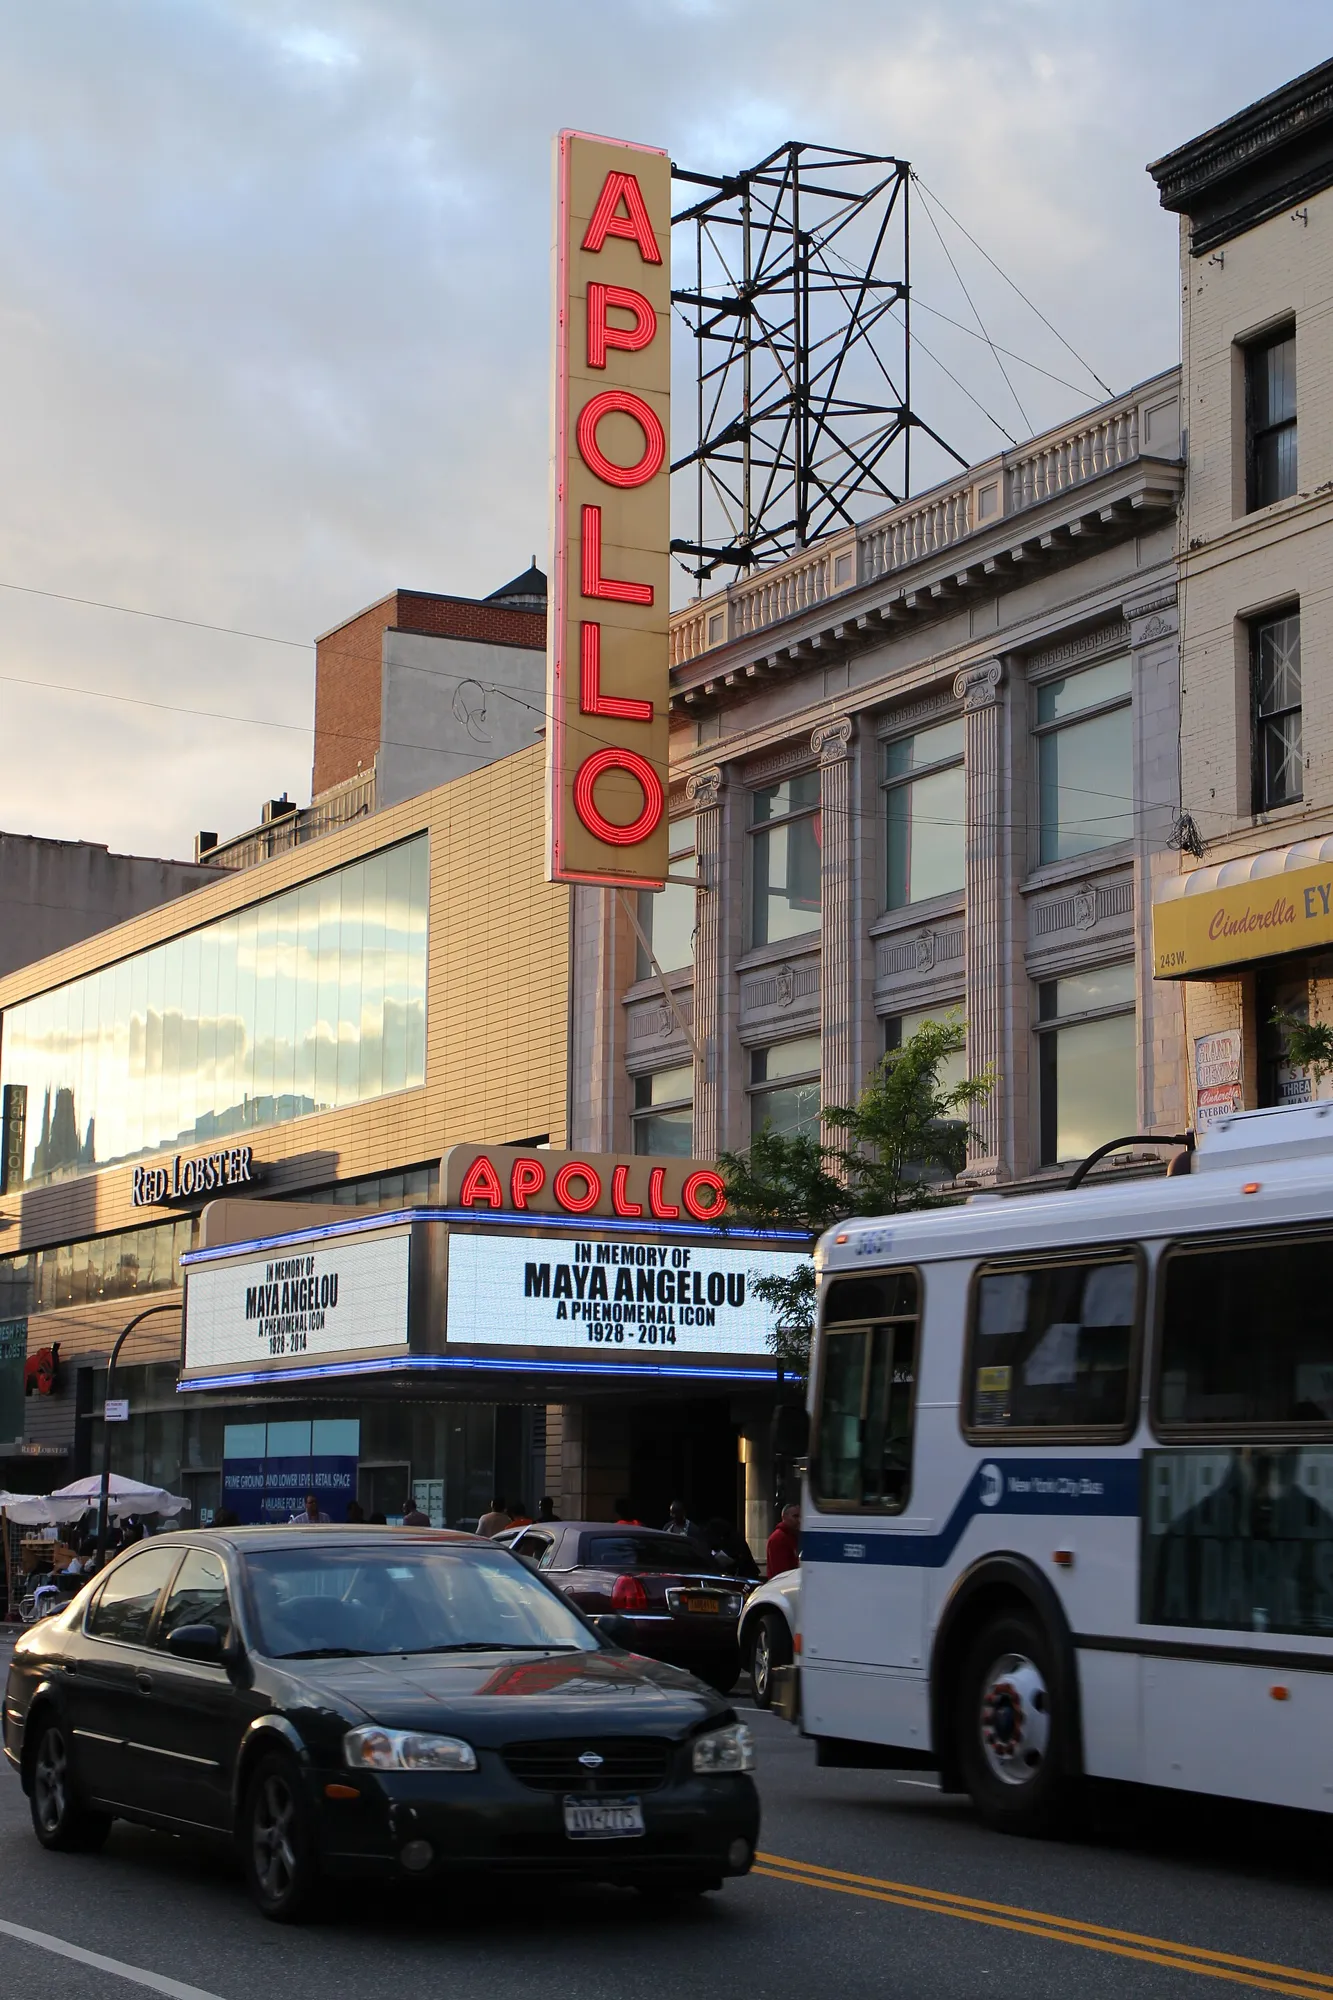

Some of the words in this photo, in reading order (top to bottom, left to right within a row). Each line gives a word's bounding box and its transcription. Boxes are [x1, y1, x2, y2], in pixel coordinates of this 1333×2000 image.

[573, 170, 667, 847] APOLLO
[1208, 897, 1297, 941] Cinderella
[1303, 882, 1332, 919] EY
[1197, 1038, 1232, 1064] GRAND
[1282, 1080, 1311, 1097] THREA
[131, 1166, 167, 1207] RED
[170, 1147, 252, 1199] LOBSTER
[460, 1155, 728, 1221] APOLLO
[575, 1243, 592, 1264] IN
[596, 1244, 668, 1268] MEMORY
[671, 1248, 691, 1268] OF
[266, 1263, 274, 1283] IN
[274, 1258, 305, 1281] MEMORY
[305, 1256, 315, 1277] OF
[246, 1283, 279, 1320] MAYA
[281, 1273, 339, 1315] ANGELOU
[524, 1262, 608, 1301] MAYA
[614, 1267, 745, 1307] ANGELOU
[258, 1320, 264, 1338] A
[264, 1313, 308, 1337] PHENOMENAL
[308, 1311, 326, 1332] ICON
[556, 1301, 567, 1320] A
[571, 1301, 675, 1325] PHENOMENAL
[679, 1306, 716, 1327] ICON
[269, 1335, 285, 1355] 1928
[290, 1333, 307, 1352] 2014
[586, 1322, 624, 1343] 1928
[638, 1324, 676, 1345] 2014
[225, 1475, 240, 1488] PRIME
[240, 1475, 264, 1488] GROUND
[266, 1474, 278, 1487] AND
[278, 1473, 297, 1487] LOWER
[298, 1473, 314, 1487] LEVEL
[315, 1473, 332, 1487] RETAIL
[333, 1473, 350, 1488] SPACE
[285, 1497, 296, 1509] FOR
[296, 1497, 306, 1509] LEA
